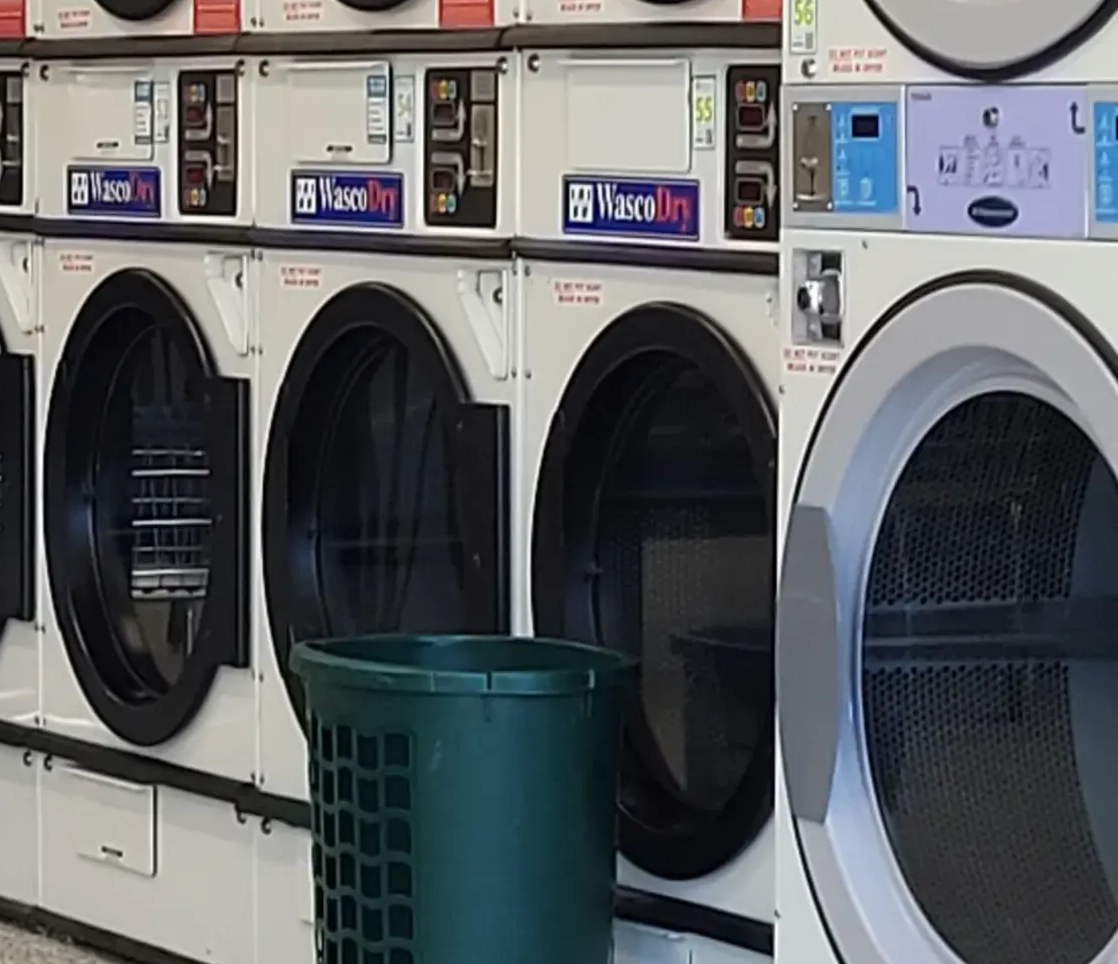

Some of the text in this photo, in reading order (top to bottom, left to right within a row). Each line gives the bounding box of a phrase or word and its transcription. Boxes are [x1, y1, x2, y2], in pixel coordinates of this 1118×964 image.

[696, 96, 712, 123] 55
[319, 176, 396, 221] WascoDry
[597, 182, 689, 234] WascoDry
